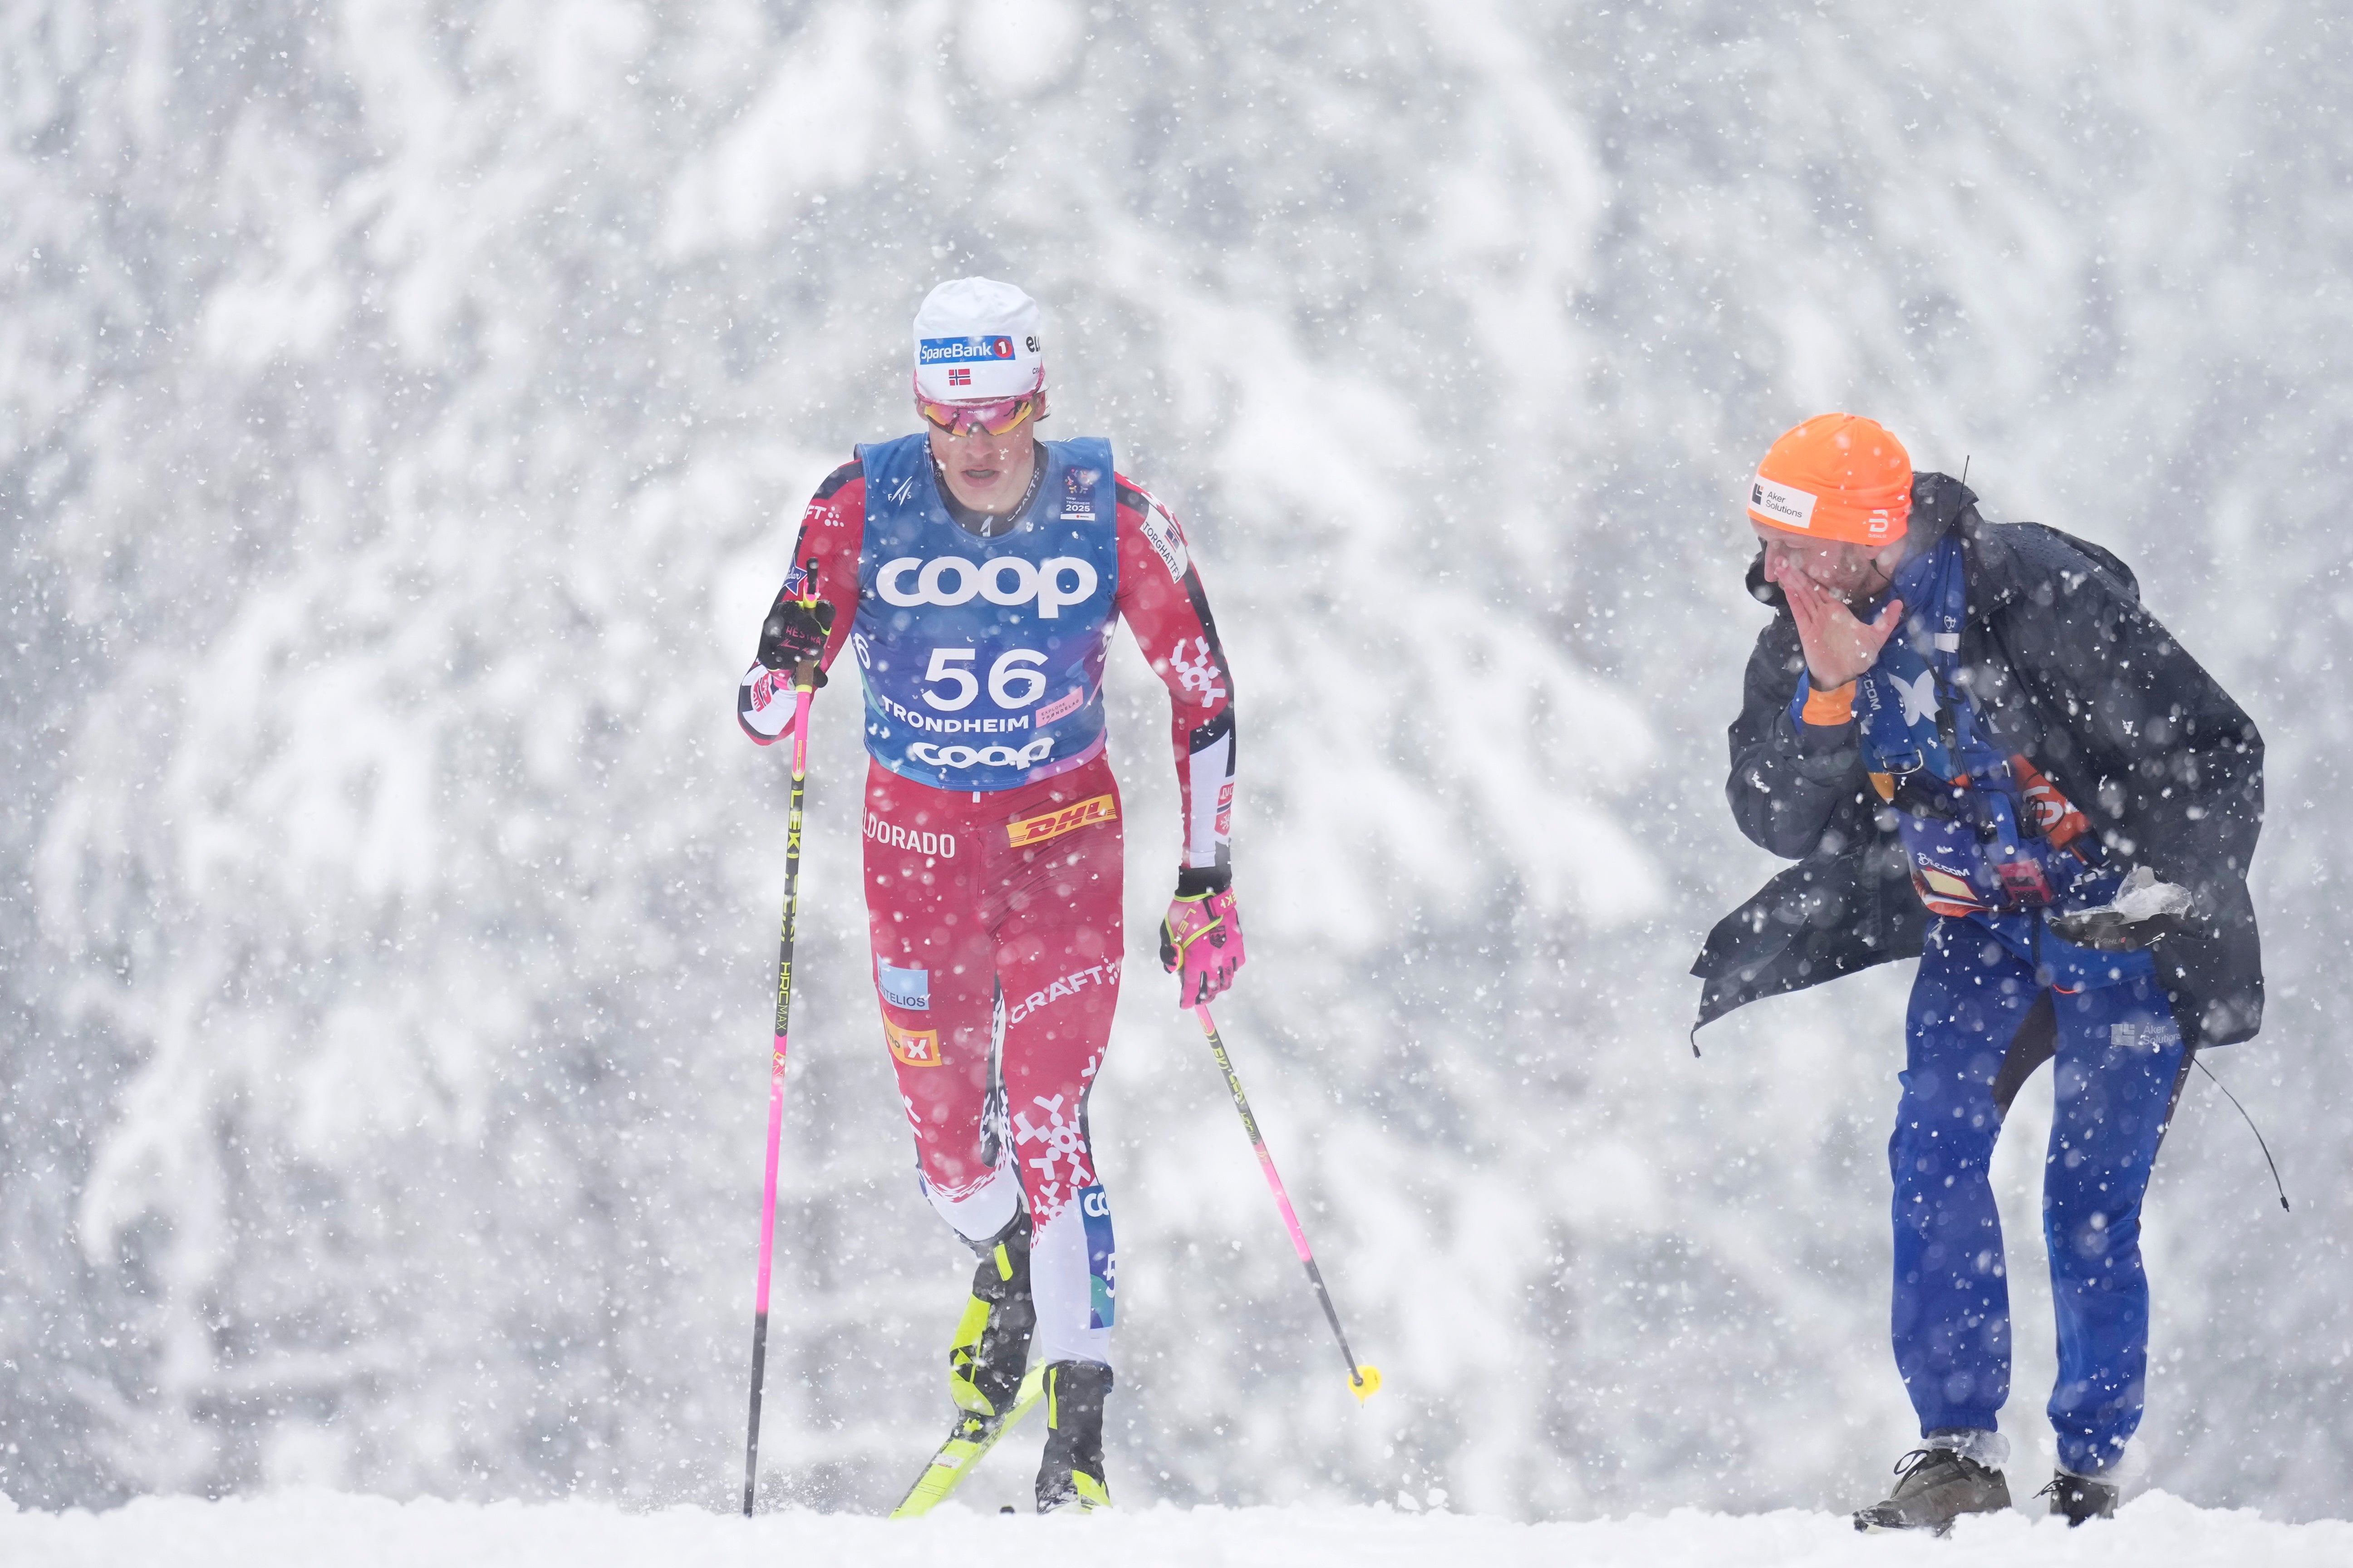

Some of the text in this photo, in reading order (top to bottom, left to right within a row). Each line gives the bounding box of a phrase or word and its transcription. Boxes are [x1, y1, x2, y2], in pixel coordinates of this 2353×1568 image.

[921, 341, 1007, 362] SpareBank 1
[1766, 500, 1802, 518] Solutions
[1767, 491, 1786, 503] Aker
[1143, 521, 1181, 582] TORGHATTEN
[876, 556, 1097, 618] coop
[922, 648, 1048, 711] 56
[881, 695, 1029, 733] TRONDHEIM
[1041, 702, 1065, 715] EXPLORE
[913, 737, 1054, 770] coop
[787, 789, 803, 858] LEKI
[1025, 801, 1106, 840] DHL
[1011, 965, 1103, 1024] CRAFT
[908, 1039, 928, 1059] X
